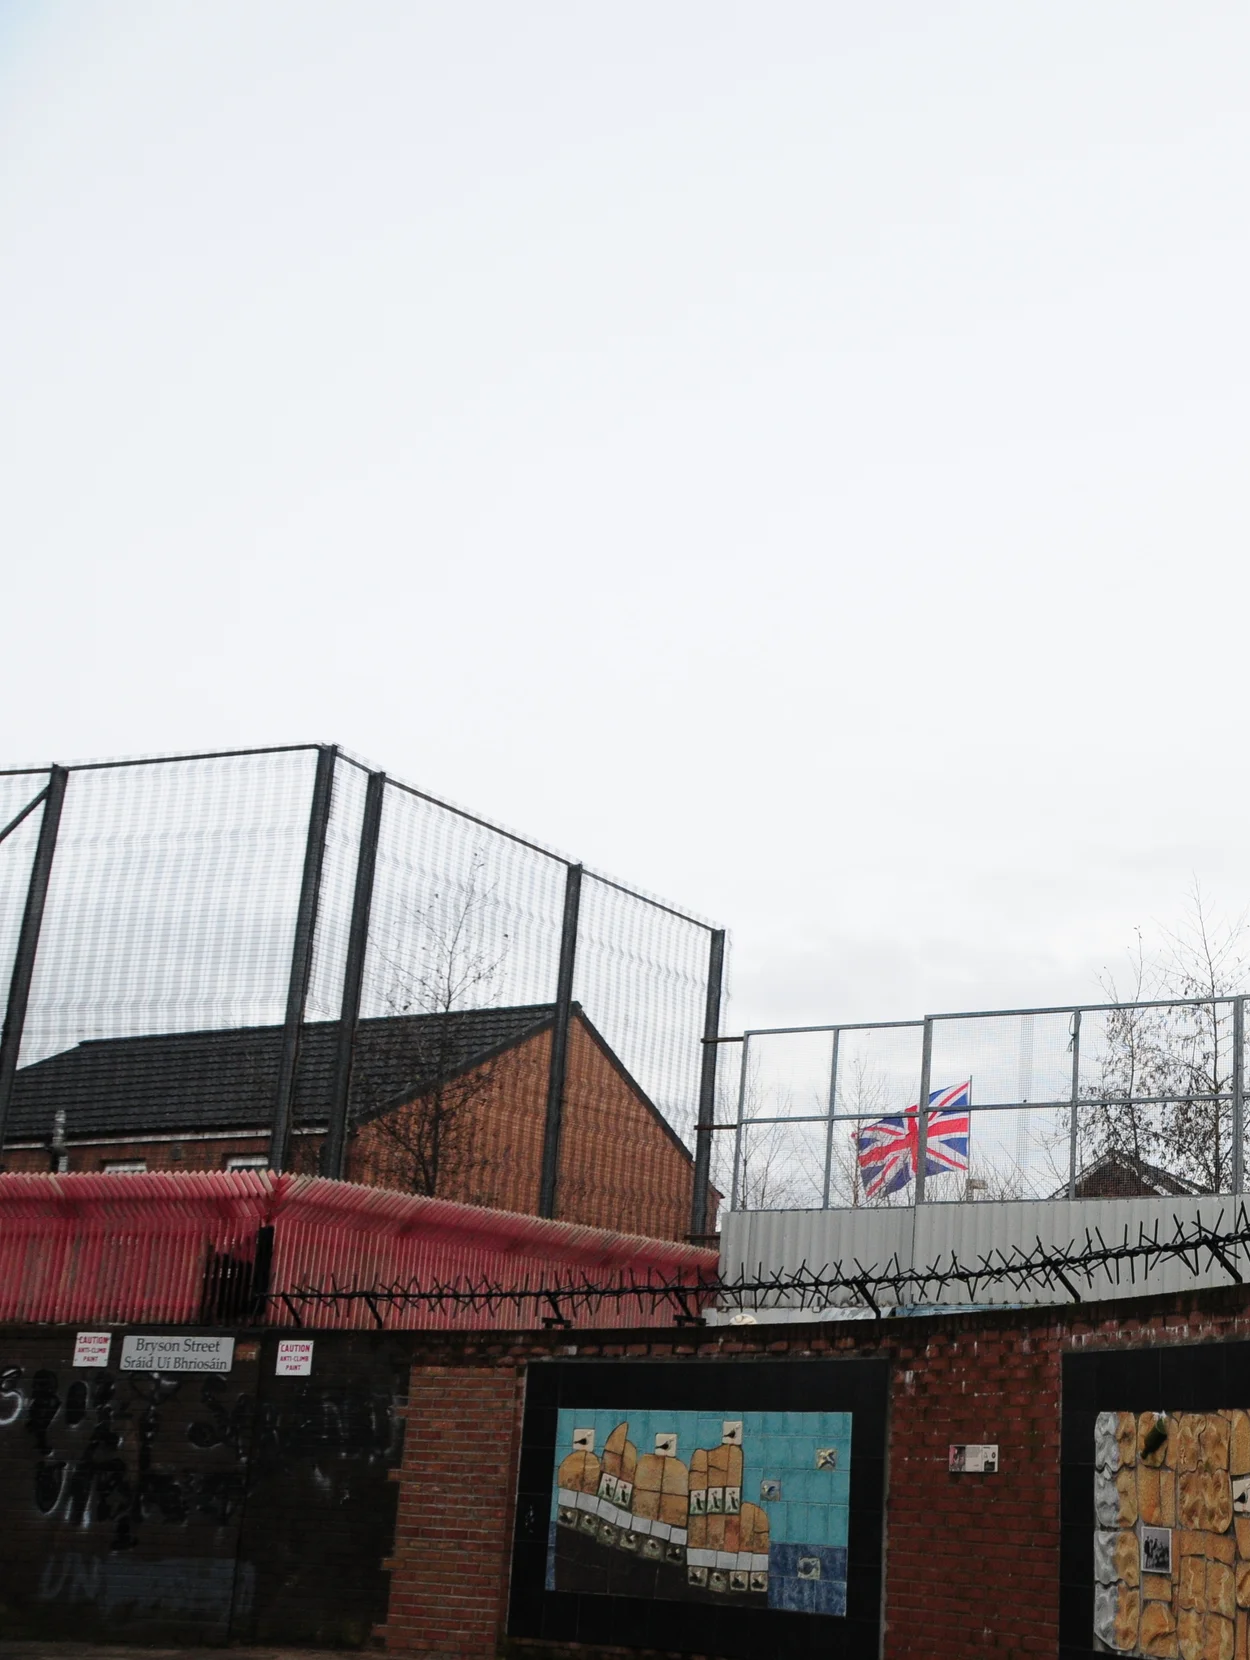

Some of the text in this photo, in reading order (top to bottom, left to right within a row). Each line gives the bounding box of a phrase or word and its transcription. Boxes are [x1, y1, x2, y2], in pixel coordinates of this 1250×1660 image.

[79, 1336, 108, 1344] CAUTION
[136, 1338, 220, 1355] Bryson Street
[281, 1344, 310, 1352] CAUTION
[123, 1356, 227, 1370] Sráid Uí Bhriosáin
